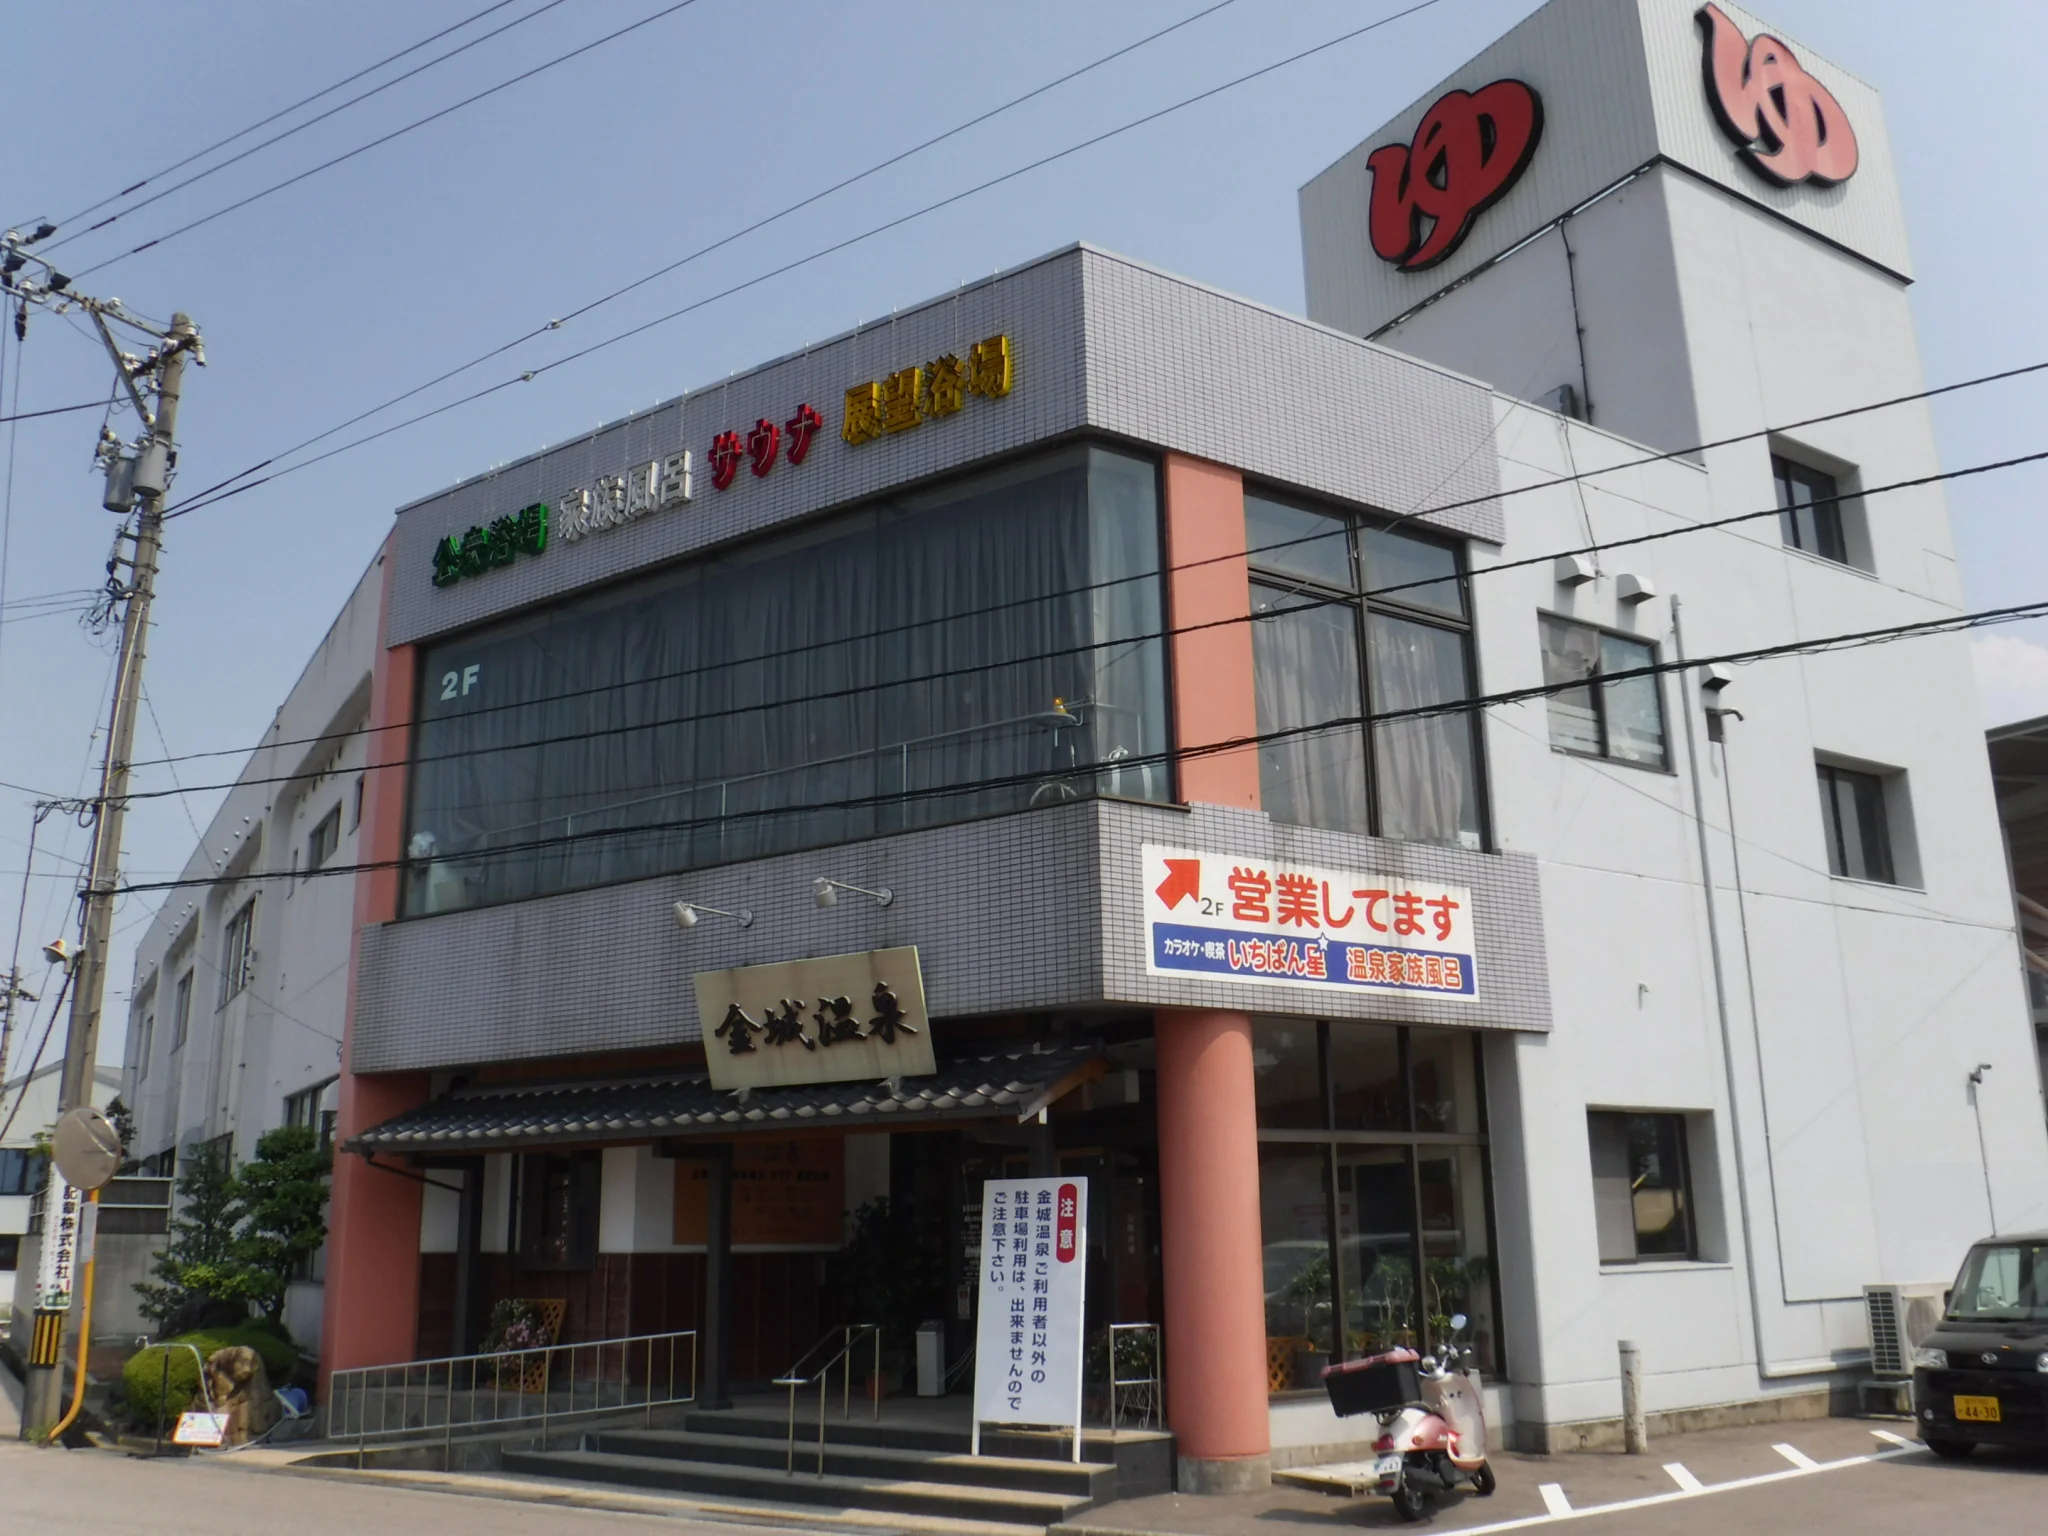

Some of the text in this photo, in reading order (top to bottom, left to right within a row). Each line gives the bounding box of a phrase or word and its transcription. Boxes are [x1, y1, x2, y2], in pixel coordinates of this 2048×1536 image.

[1695, 3, 1858, 190] ゆ
[1366, 78, 1543, 272] ゆ
[557, 449, 693, 543] 家族風呂
[708, 402, 823, 491] サウナ
[841, 333, 1013, 446] 展望浴場
[440, 663, 481, 701] 2F
[1201, 865, 1460, 941] 2F 営業してます
[1163, 937, 1463, 990] カラオケ・喫茶 いちばん星 温泉家族風呂
[714, 981, 918, 1054] 金城温泉
[990, 1191, 1007, 1292] ご注意下さい。
[1059, 1197, 1075, 1250] 注意
[1006, 1190, 1030, 1411] 駐車場利用は、出来ませんので
[1030, 1189, 1052, 1384] 金城温泉ご利用者以外の
